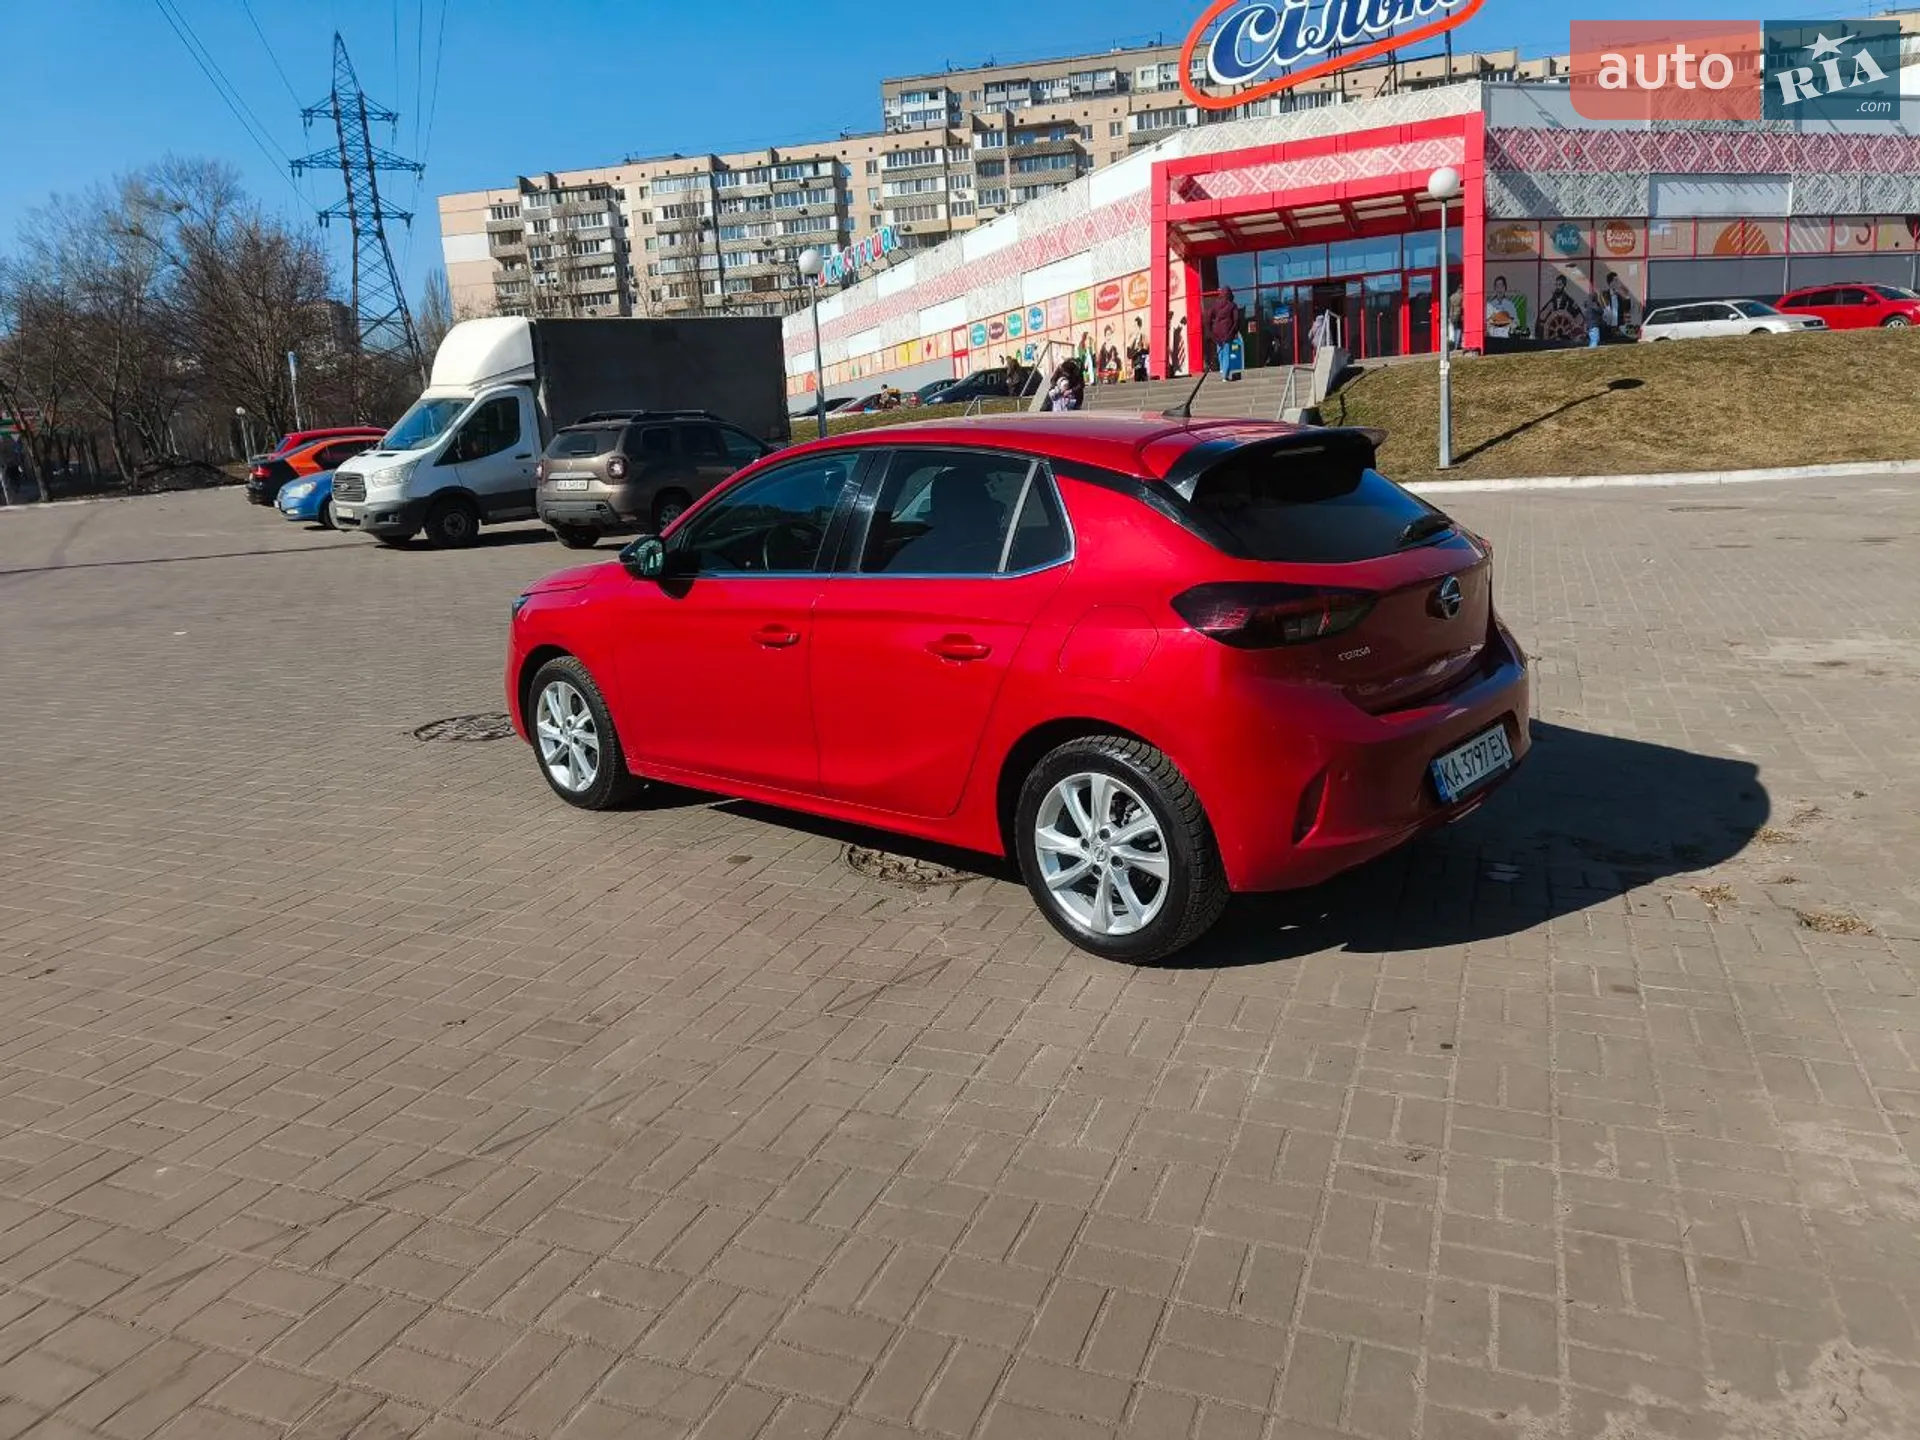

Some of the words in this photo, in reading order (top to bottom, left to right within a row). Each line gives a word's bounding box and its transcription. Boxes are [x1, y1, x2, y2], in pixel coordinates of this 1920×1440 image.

[1440, 758, 1464, 790] KA
[1460, 742, 1490, 777] 3797
[1488, 730, 1509, 761] EX
